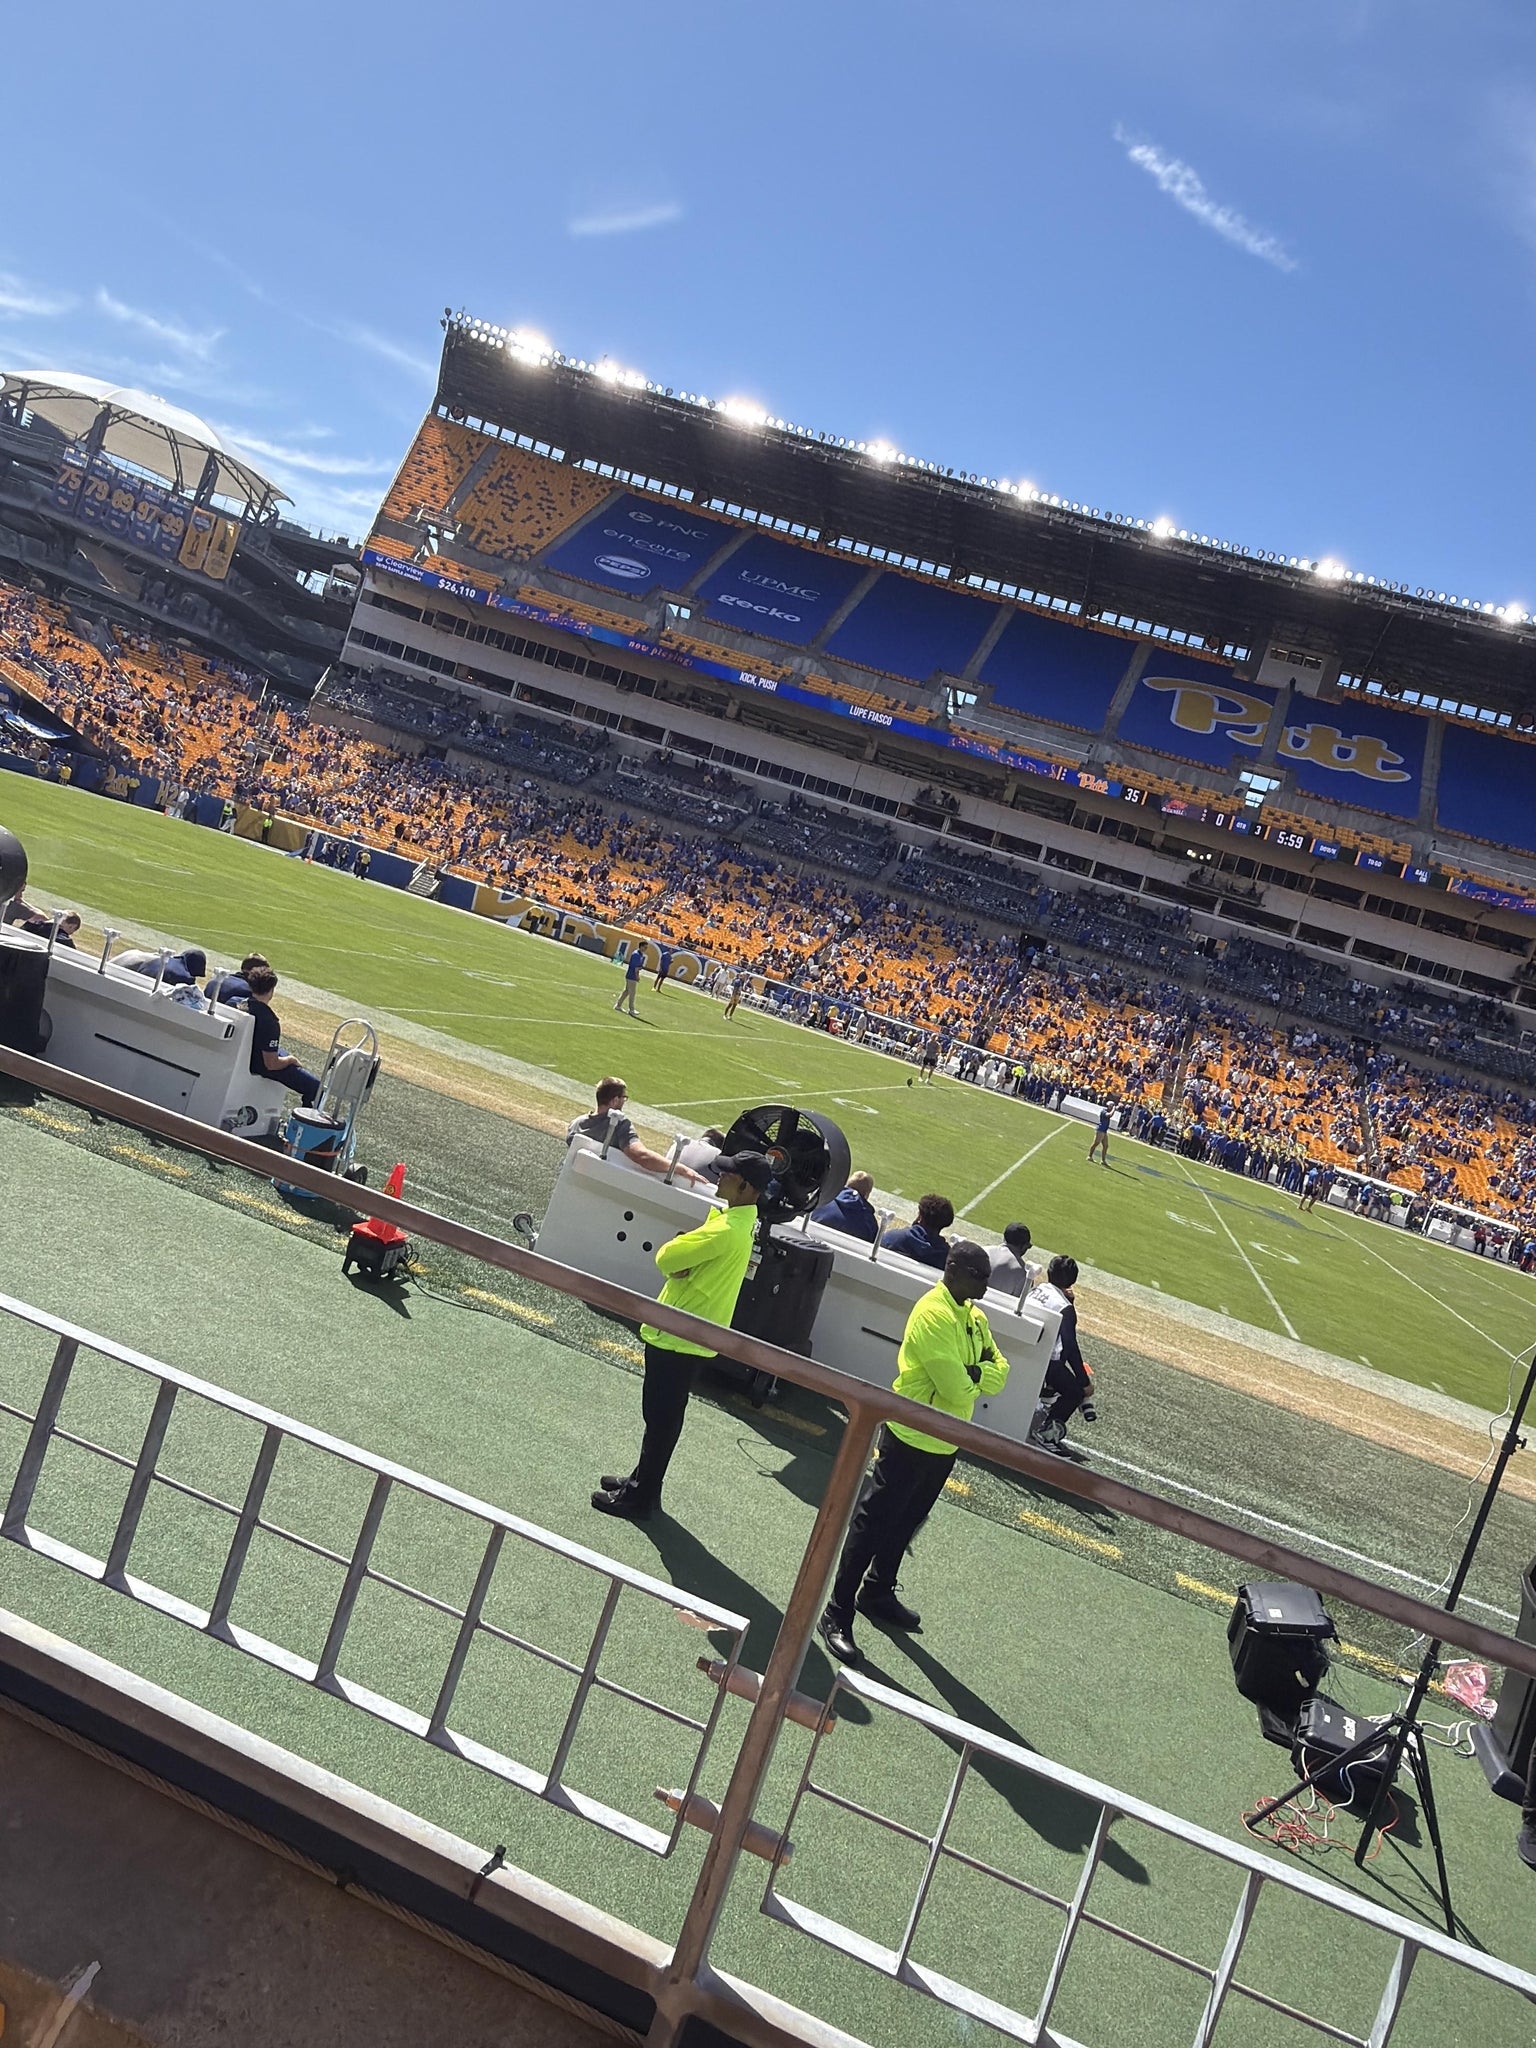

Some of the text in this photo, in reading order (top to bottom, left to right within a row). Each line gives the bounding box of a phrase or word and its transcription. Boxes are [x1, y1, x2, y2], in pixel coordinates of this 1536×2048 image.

[57, 465, 84, 490] 75
[84, 475, 110, 501] 79
[111, 488, 135, 513] 89
[136, 500, 161, 524] 97
[161, 512, 185, 537] 99
[657, 520, 709, 540] PNC
[603, 528, 691, 560] encore
[385, 557, 424, 577] Clearview
[438, 578, 476, 598] $26,110
[741, 570, 821, 600] UPMC
[718, 594, 801, 622] gecko
[629, 641, 649, 652] now
[739, 671, 778, 692] KICK, PUSH
[849, 704, 893, 726] LUPE FIASCO
[1143, 676, 1412, 783] Pitt
[1077, 772, 1108, 795] Pitt
[1124, 788, 1141, 803] 35
[1215, 813, 1224, 827] 0
[1254, 825, 1262, 835] 3
[1276, 831, 1304, 850] 5:59
